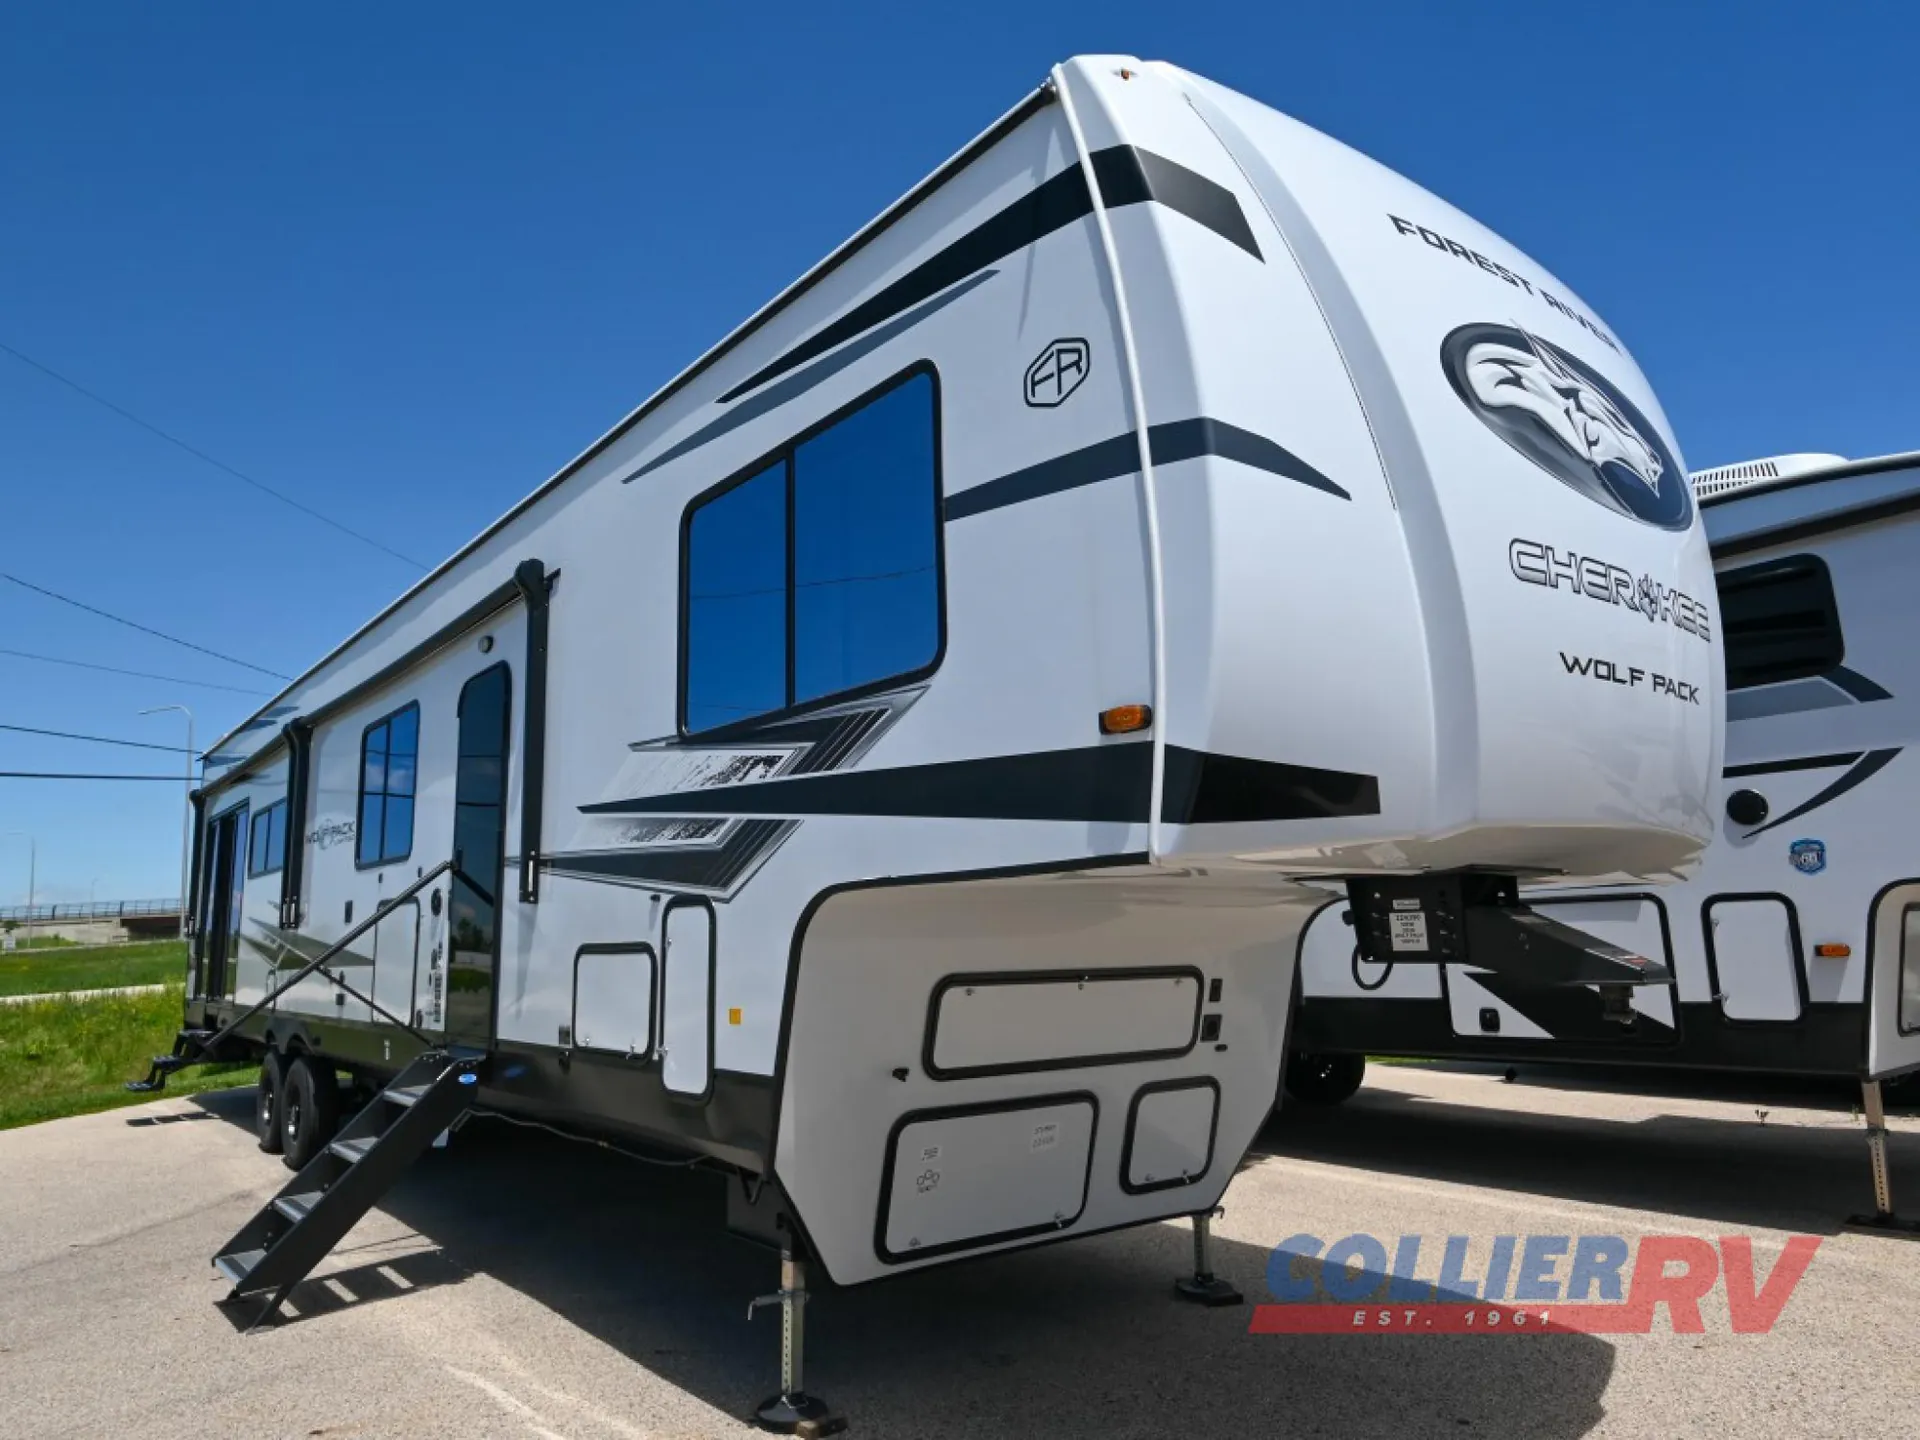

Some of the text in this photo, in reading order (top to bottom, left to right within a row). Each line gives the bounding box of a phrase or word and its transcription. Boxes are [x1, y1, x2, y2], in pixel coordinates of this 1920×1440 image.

[1387, 213, 1622, 355] FOREST RIVER
[1559, 651, 1700, 705] WOLF PACK
